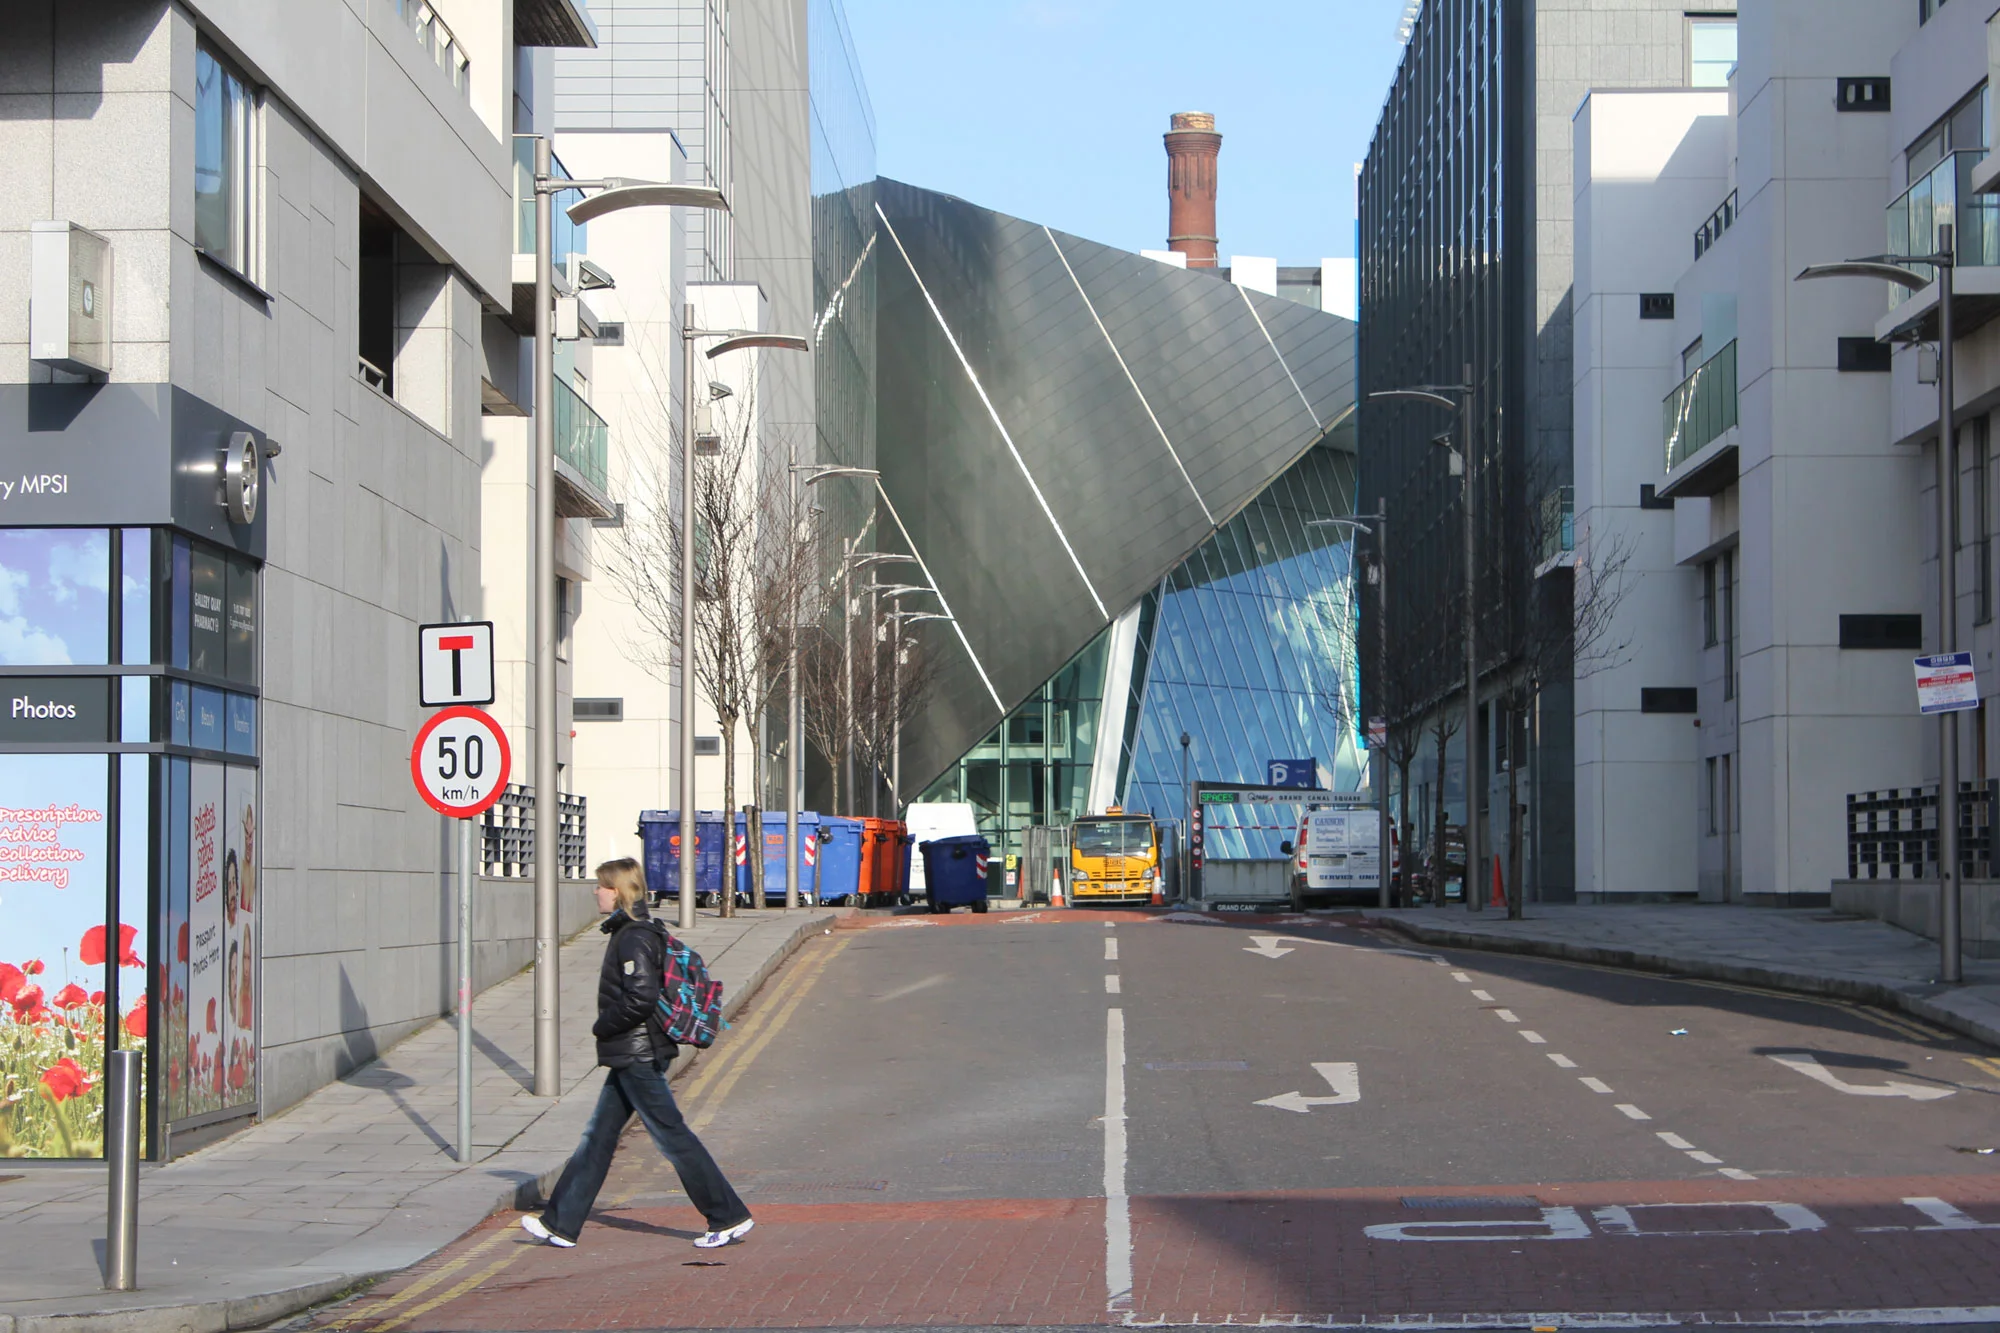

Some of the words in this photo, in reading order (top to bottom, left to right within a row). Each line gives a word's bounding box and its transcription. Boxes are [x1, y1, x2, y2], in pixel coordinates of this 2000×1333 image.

[20, 474, 68, 494] MPSI
[194, 592, 210, 610] GALLERY
[210, 596, 222, 613] QUAY
[194, 613, 215, 632] PHARMACY
[12, 695, 76, 719] Photos
[438, 734, 483, 780] 50
[442, 784, 479, 801] km/h
[1201, 792, 1234, 802] SPACES
[0, 803, 102, 828] Prescription
[0, 823, 57, 842] Advice
[0, 843, 85, 862] Collection
[0, 863, 69, 889] Delivery
